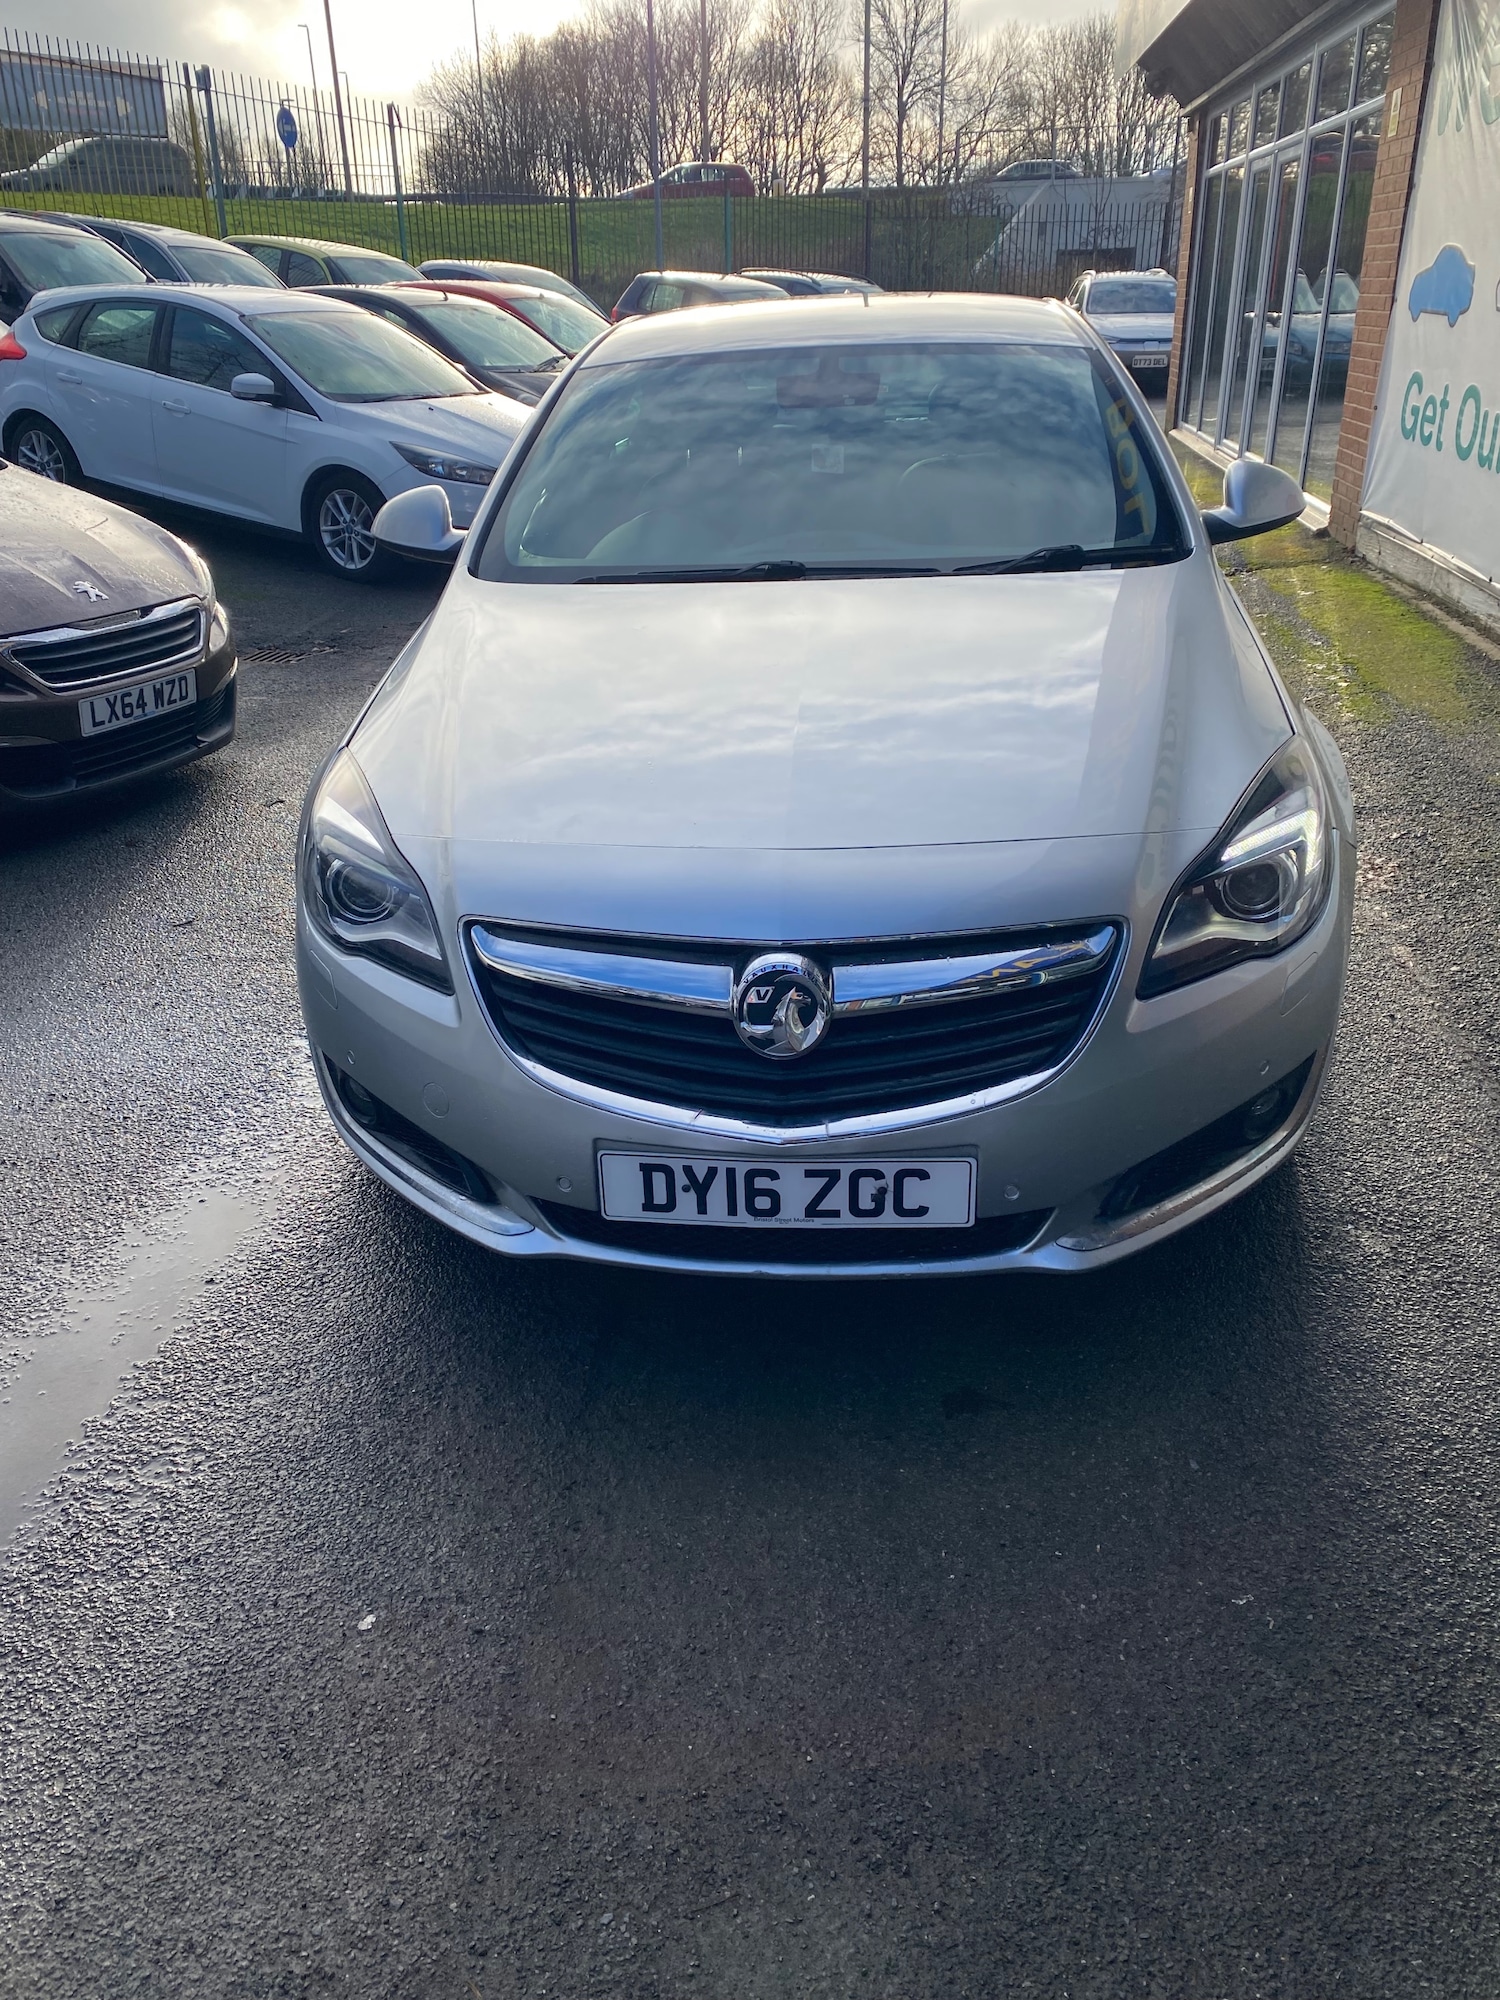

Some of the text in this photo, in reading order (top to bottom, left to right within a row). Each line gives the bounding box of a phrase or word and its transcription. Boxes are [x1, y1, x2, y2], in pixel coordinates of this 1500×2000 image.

[1401, 371, 1500, 474] Get Ou
[89, 675, 189, 728] LX64 WZD
[743, 963, 818, 985] VAUXHALL
[638, 1162, 931, 1219] DY16 ZGC
